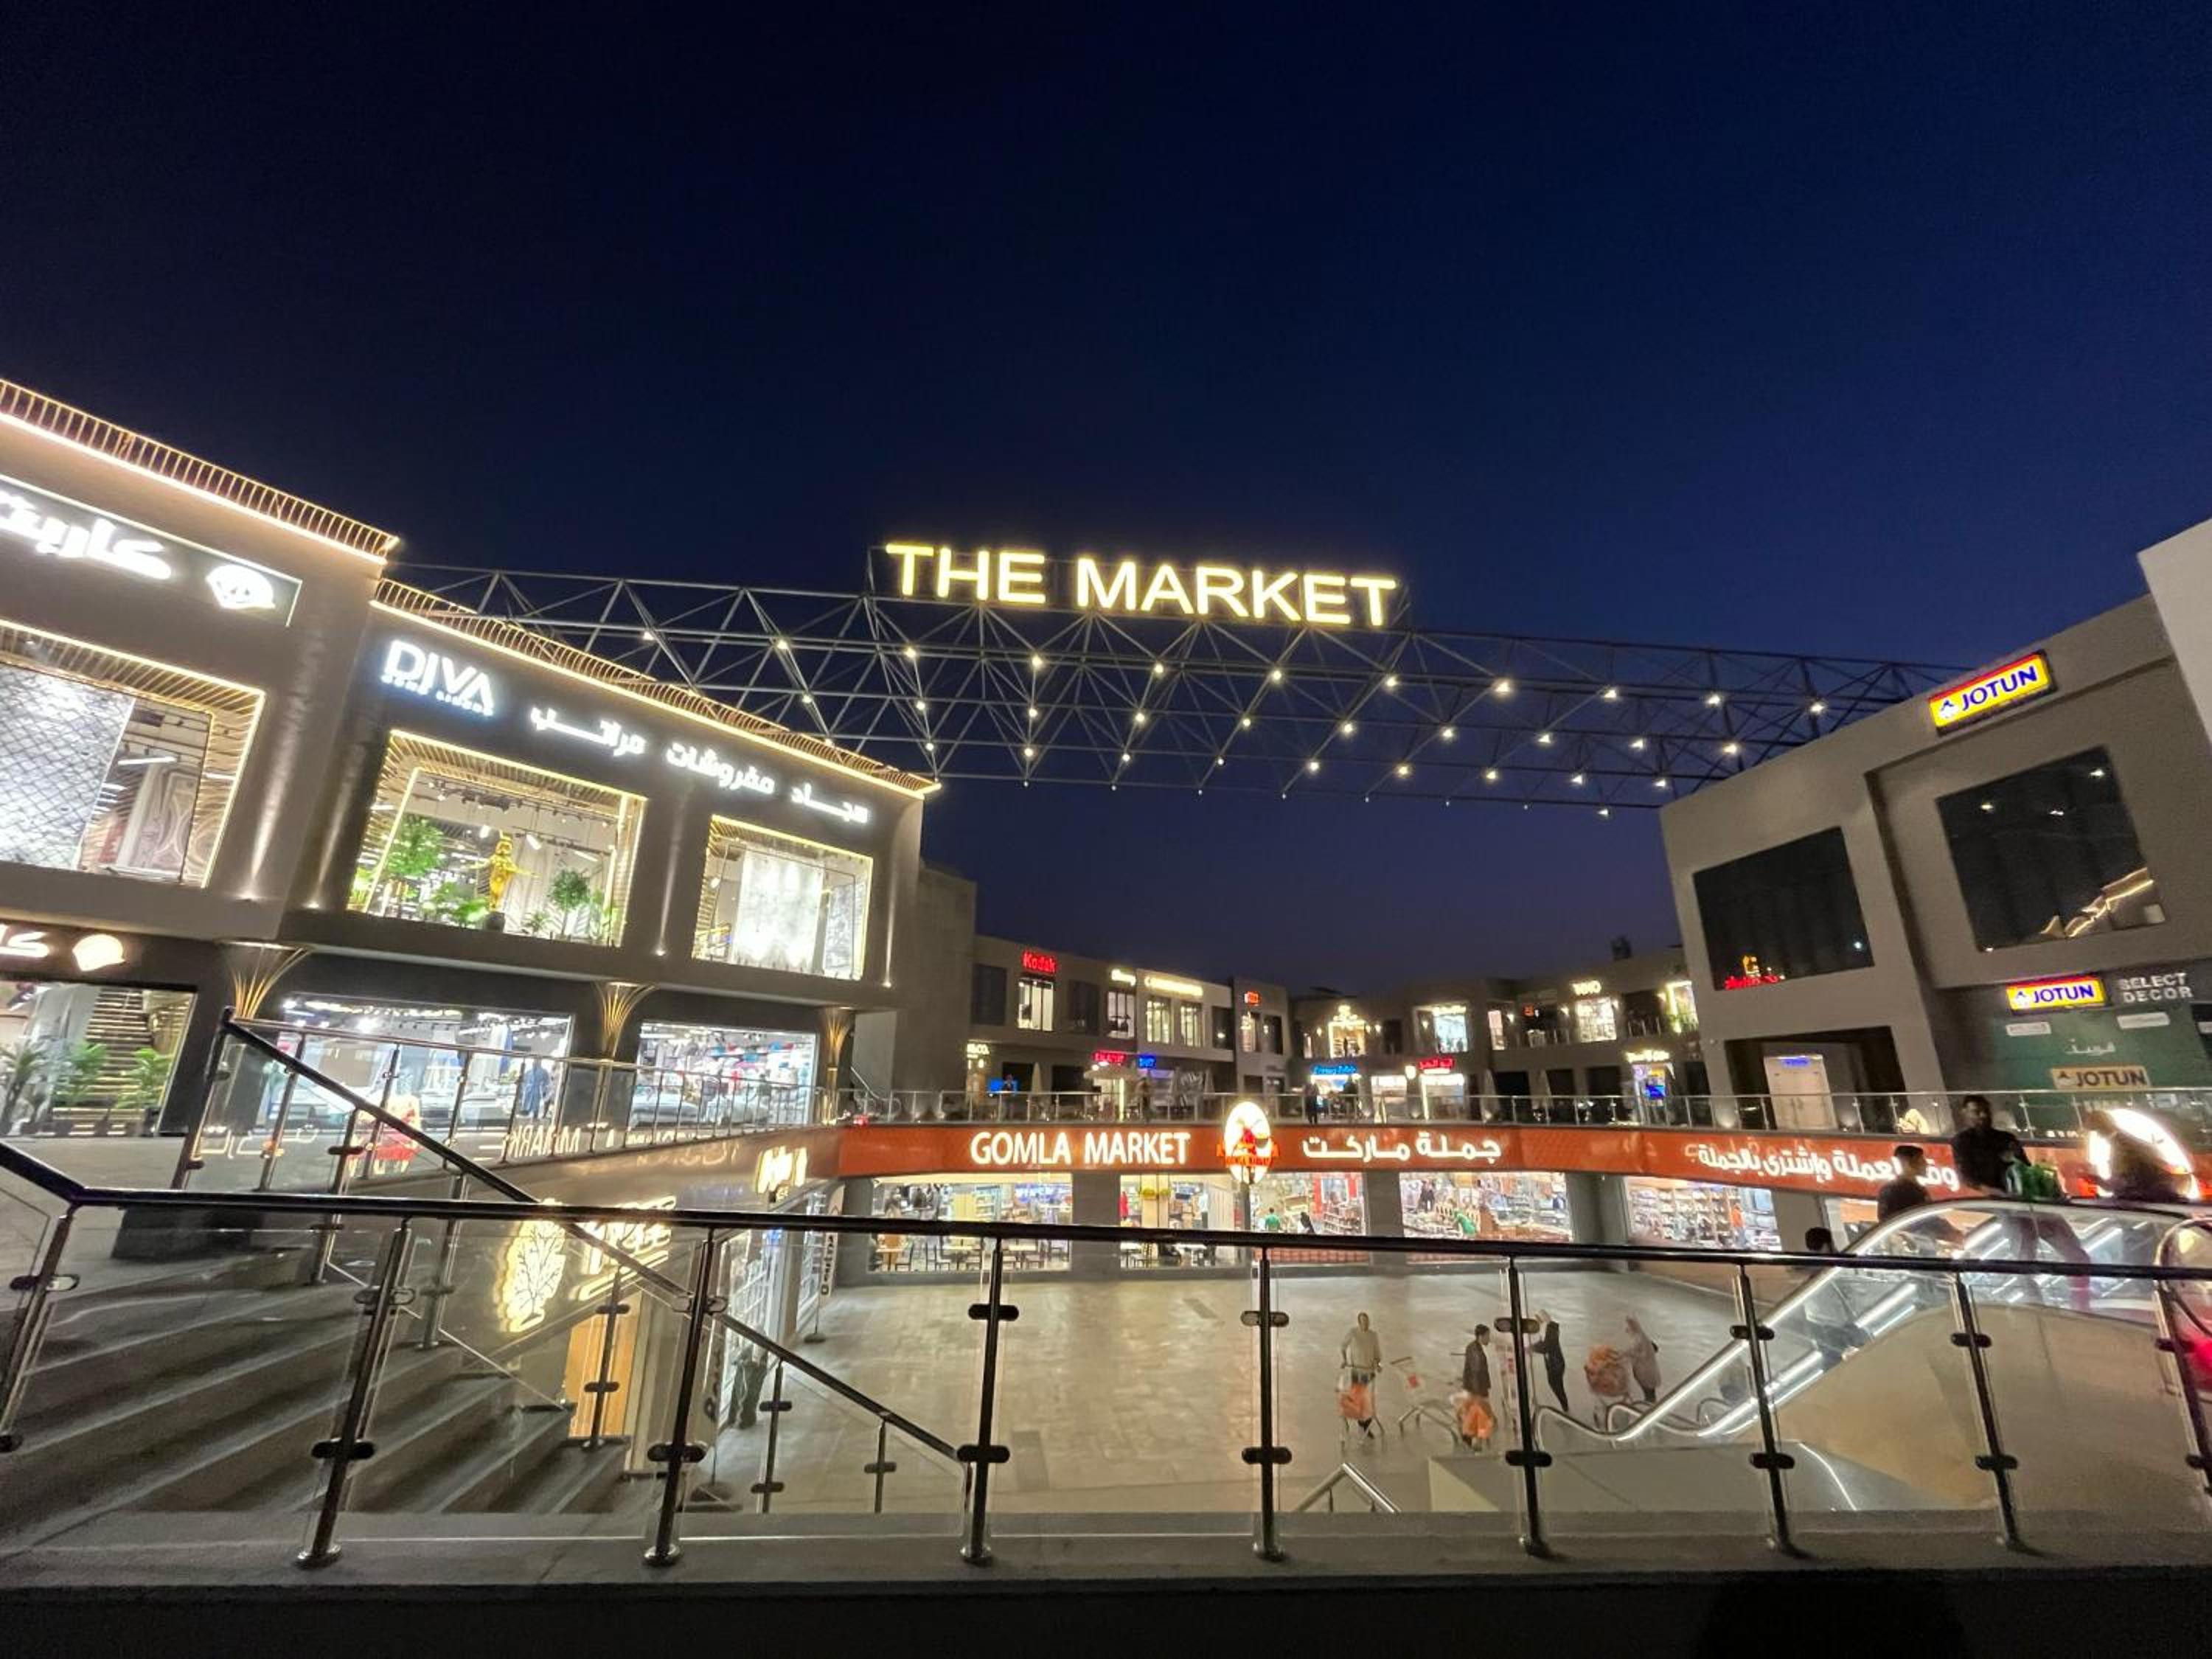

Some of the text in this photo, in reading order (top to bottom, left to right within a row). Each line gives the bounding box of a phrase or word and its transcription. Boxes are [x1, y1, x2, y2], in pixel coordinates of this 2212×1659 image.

[885, 542, 1397, 627] THE MARKET
[383, 639, 495, 709] DIVA
[1961, 665, 2038, 712] JOTUN
[666, 741, 776, 795] مفروشات
[2033, 984, 2096, 1004] JOTUN
[2118, 973, 2187, 991] SELECT
[2123, 986, 2194, 1004] DECOR
[2076, 1069, 2146, 1087] JOTUN
[970, 1130, 1072, 1165] GOMLA
[1084, 1130, 1191, 1164] MARKET
[1301, 1133, 1411, 1163] ماركت
[1416, 1131, 1502, 1164] جملة
[1698, 1143, 1764, 1177] بالجملة
